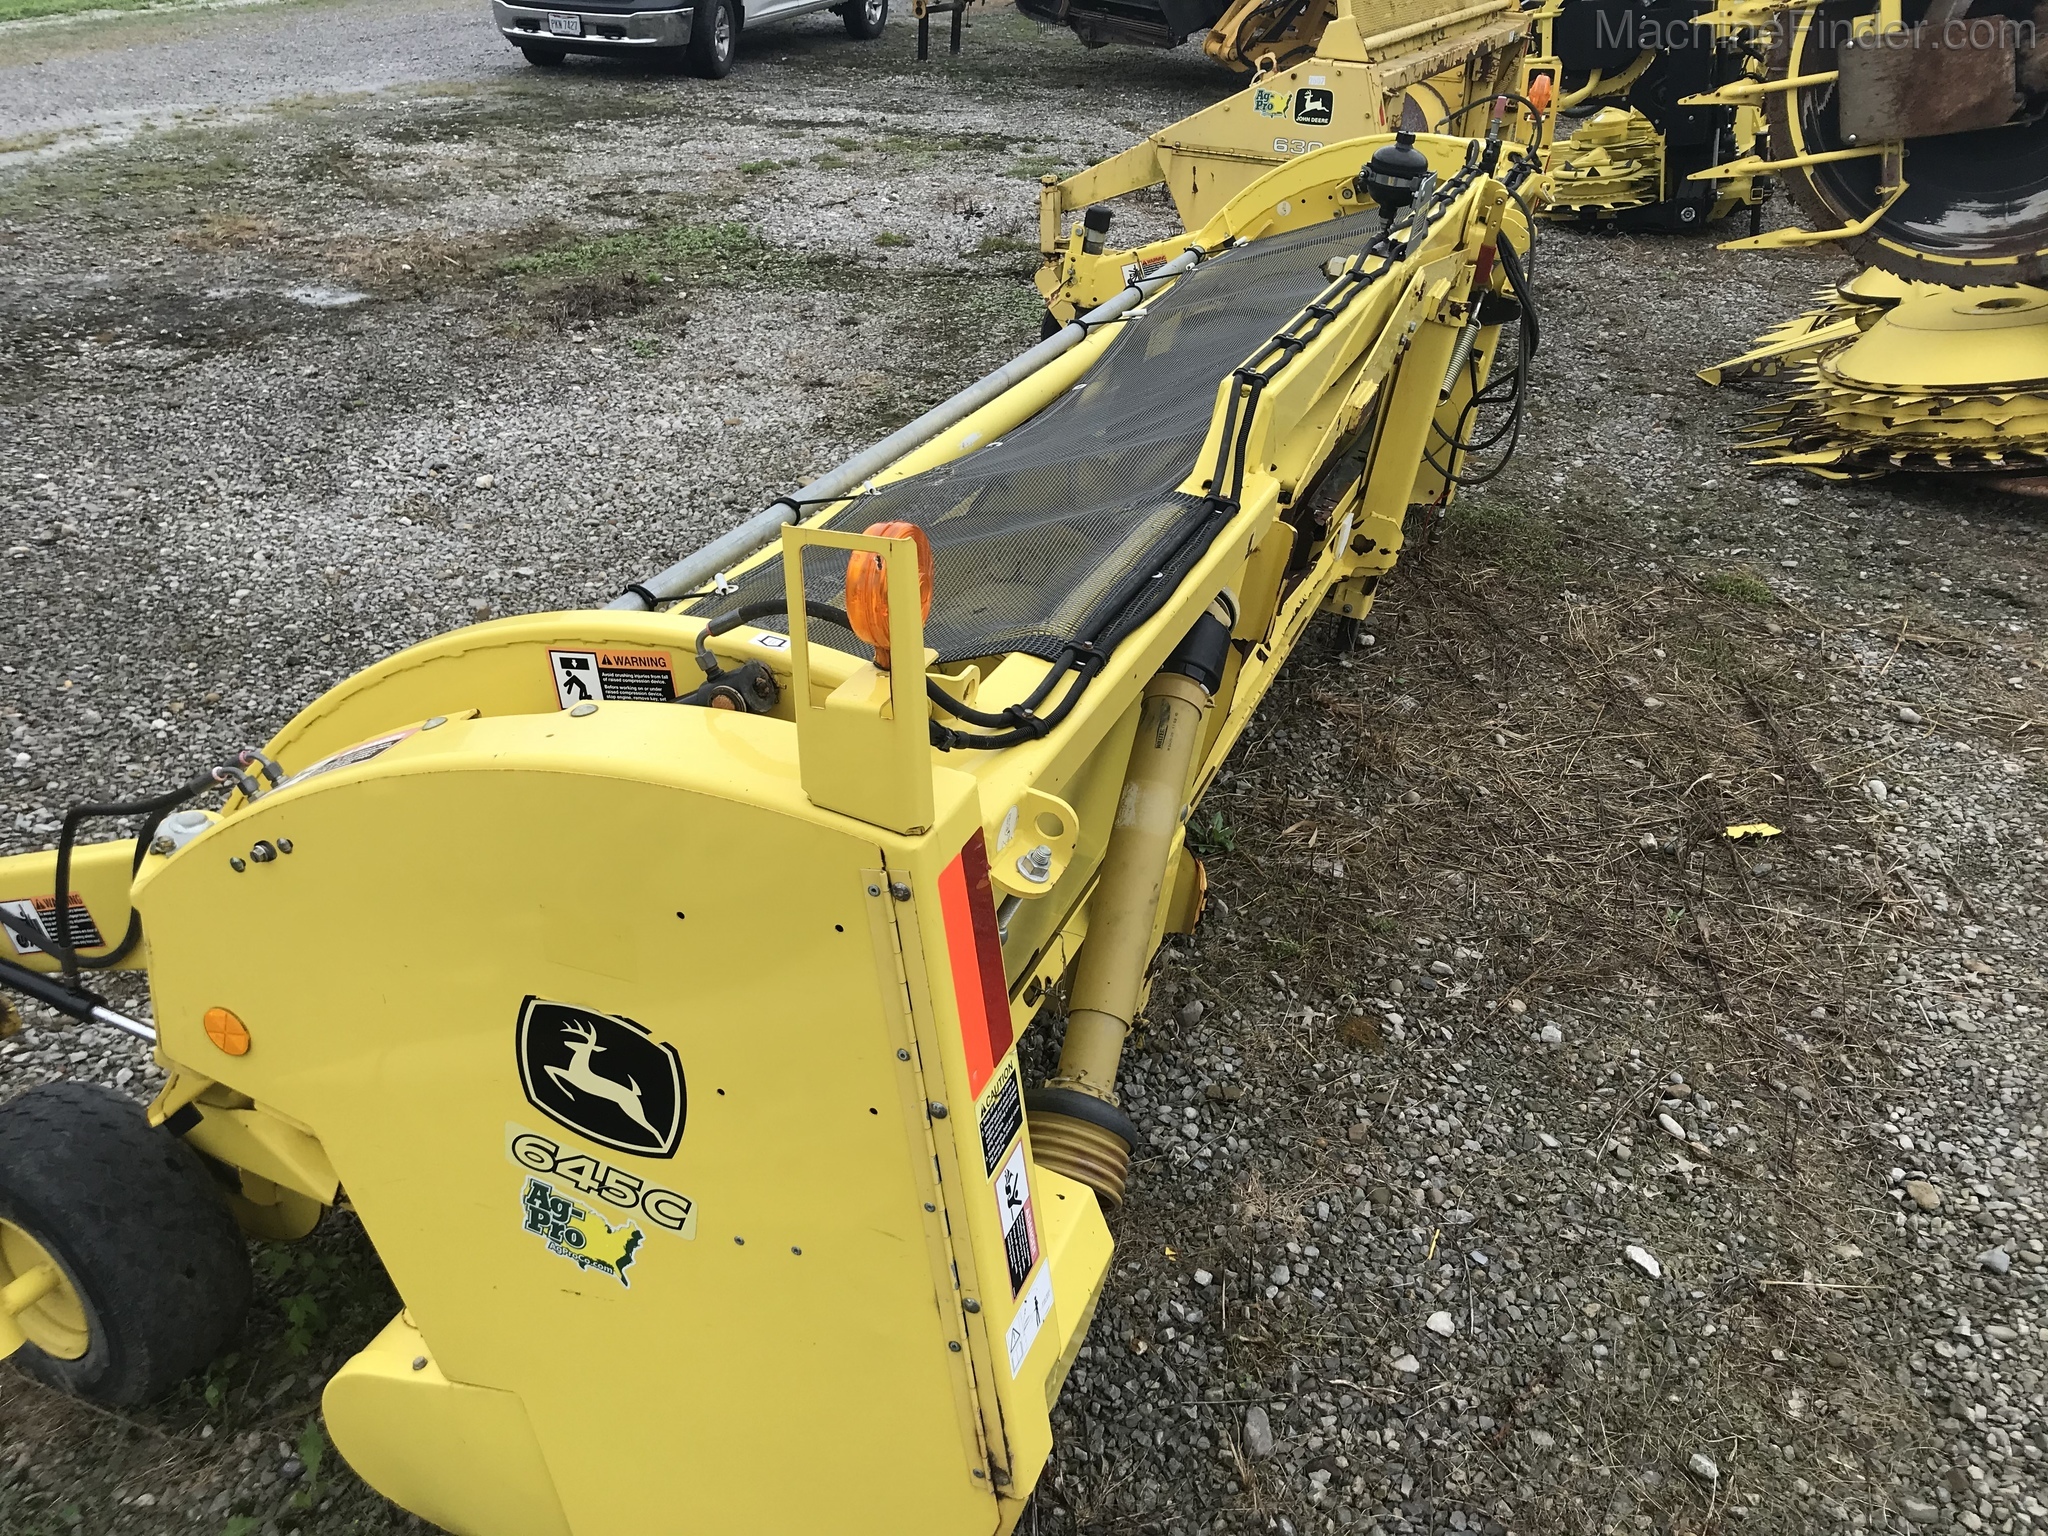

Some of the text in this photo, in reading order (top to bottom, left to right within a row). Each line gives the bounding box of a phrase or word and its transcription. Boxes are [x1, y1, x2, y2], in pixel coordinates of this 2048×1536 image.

[1255, 90, 1275, 101] Ag-
[1255, 100, 1274, 111] Pro
[613, 655, 667, 668] WARNING
[985, 1060, 1013, 1107] CAUTION
[511, 1133, 693, 1231] 645C
[525, 1178, 587, 1222] Ag-
[525, 1205, 587, 1249] Pro
[547, 1241, 615, 1276] AgProCo.com
